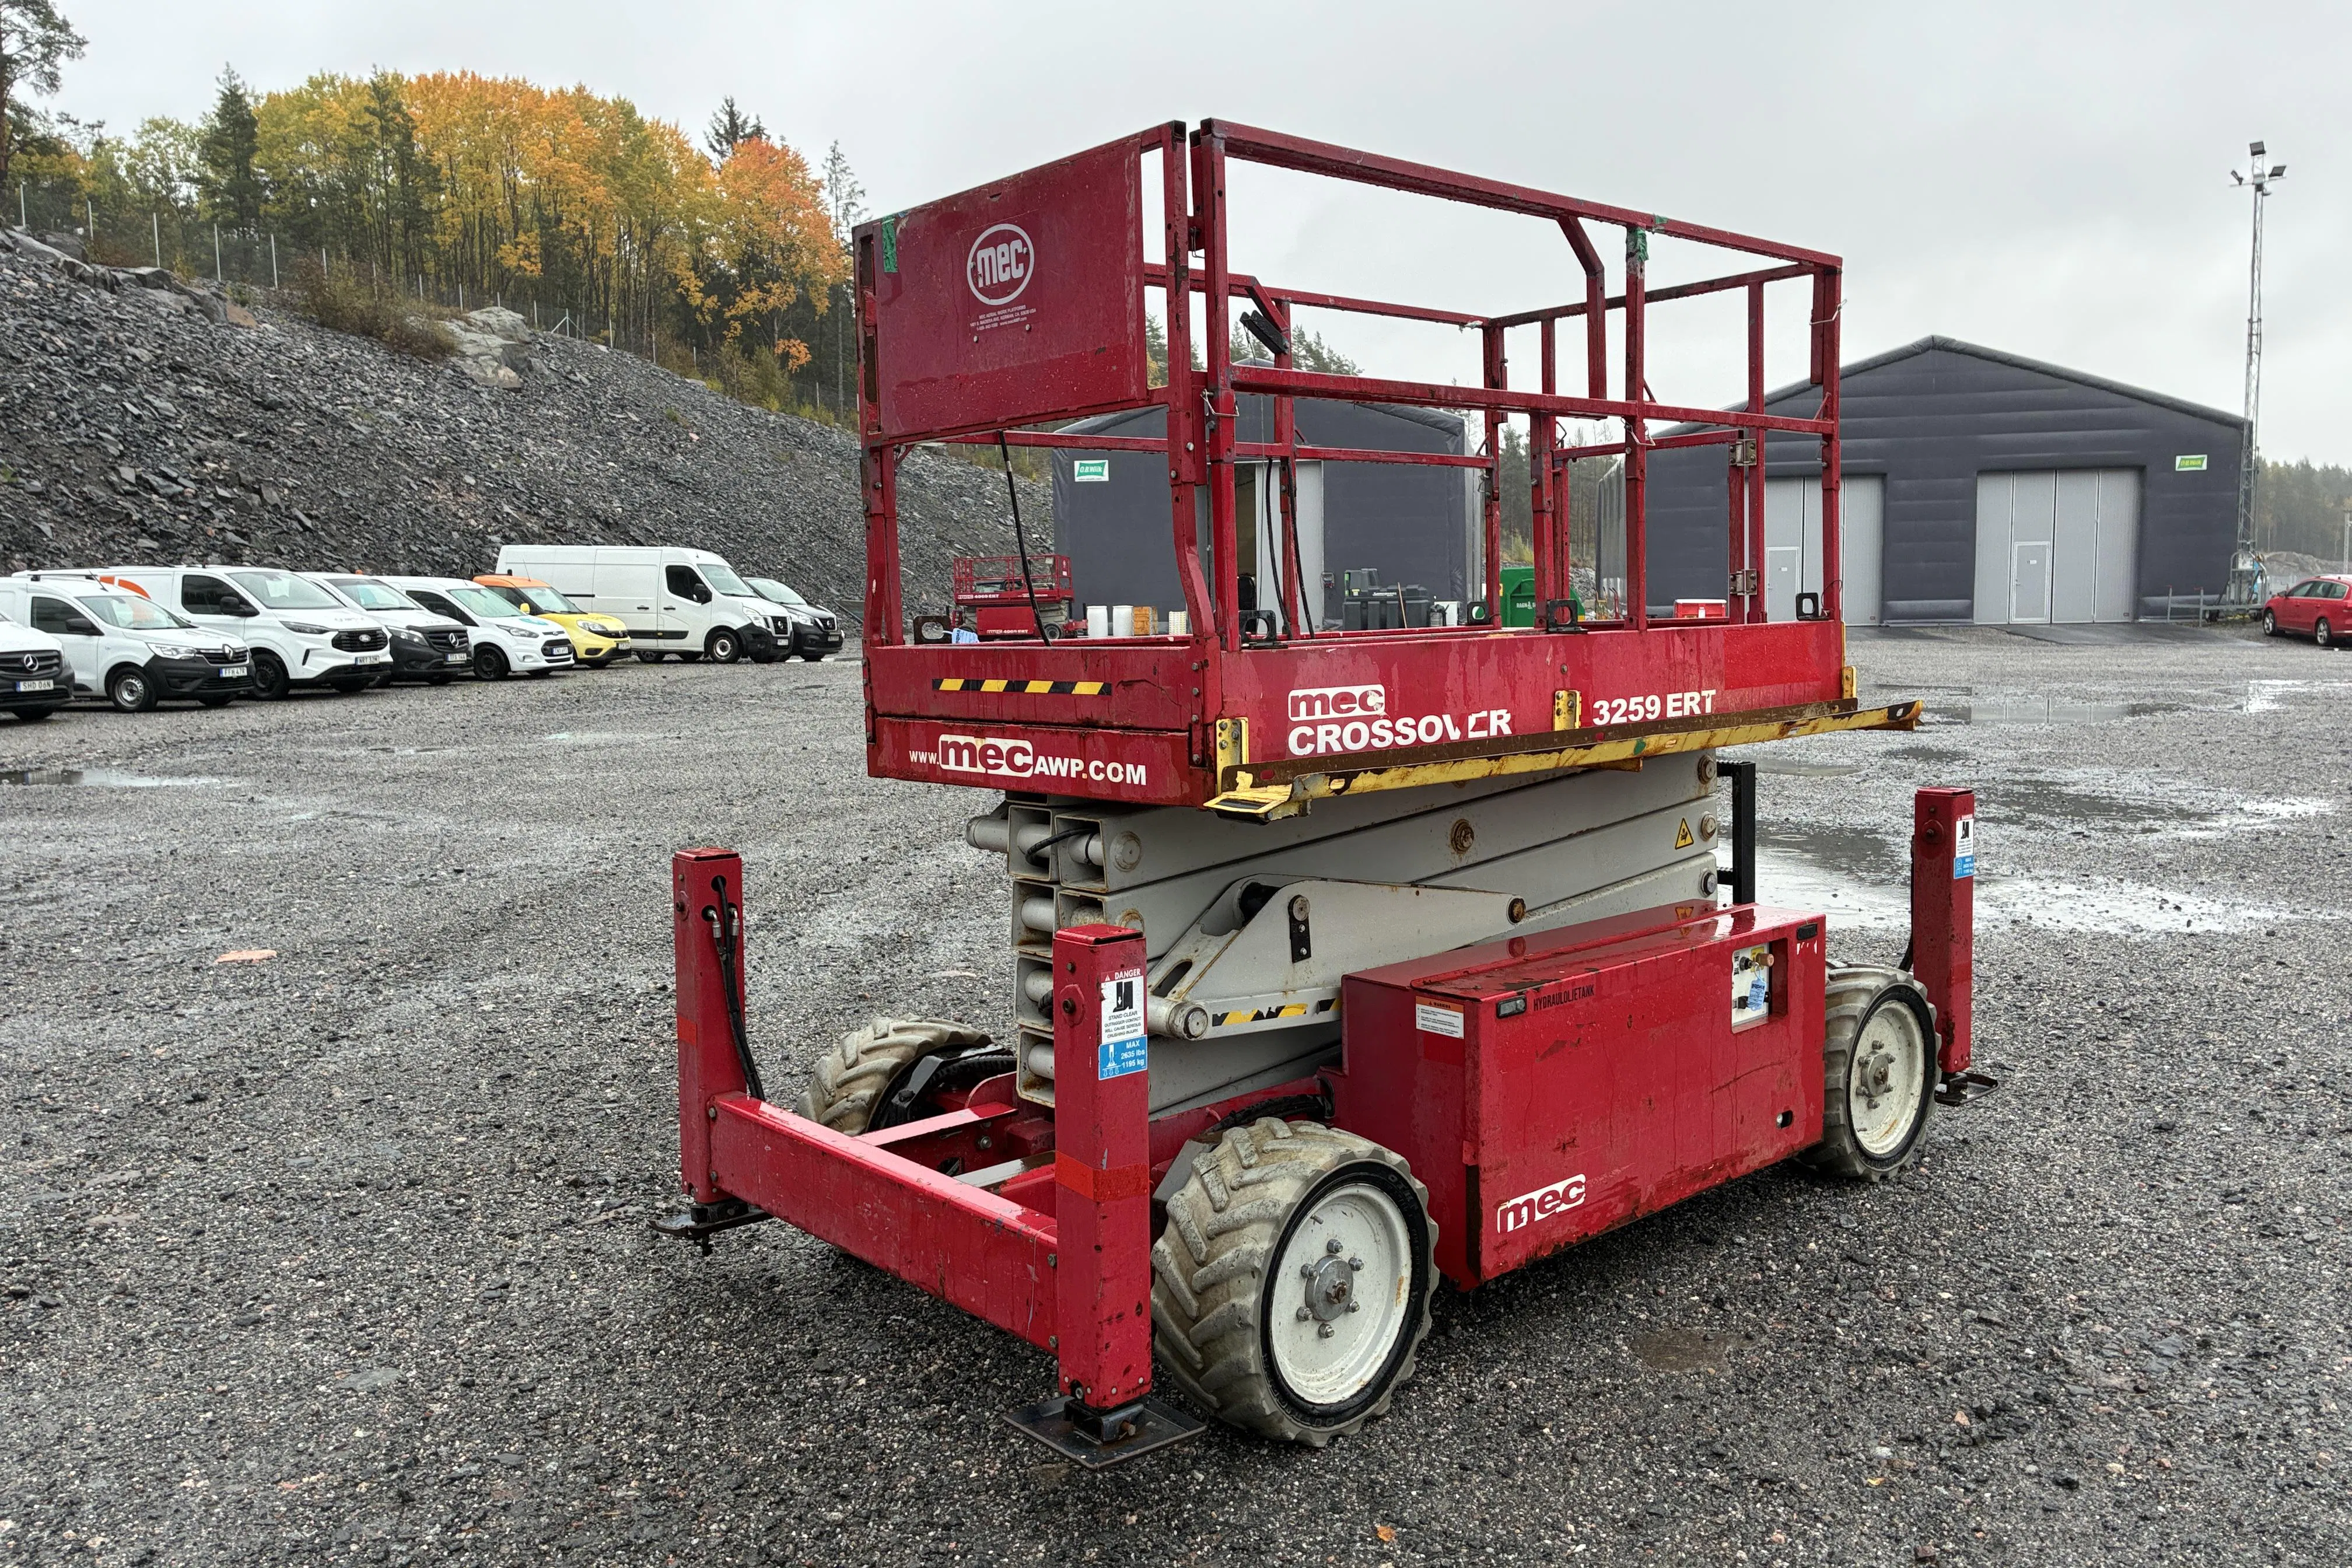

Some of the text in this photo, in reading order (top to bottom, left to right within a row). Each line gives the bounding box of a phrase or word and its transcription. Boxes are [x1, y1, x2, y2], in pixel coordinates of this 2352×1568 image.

[977, 239, 1024, 288] mec
[1290, 688, 1384, 719] mec
[1592, 689, 1717, 726] 3259 ERT
[1114, 968, 1141, 980] DANGER
[1533, 984, 1595, 1012] HYDRAULOLJETANK
[1121, 1050, 1135, 1059] 2635
[1126, 1040, 1140, 1049] MAX
[1121, 1059, 1136, 1068] 1195
[1498, 1177, 1586, 1233] mec
